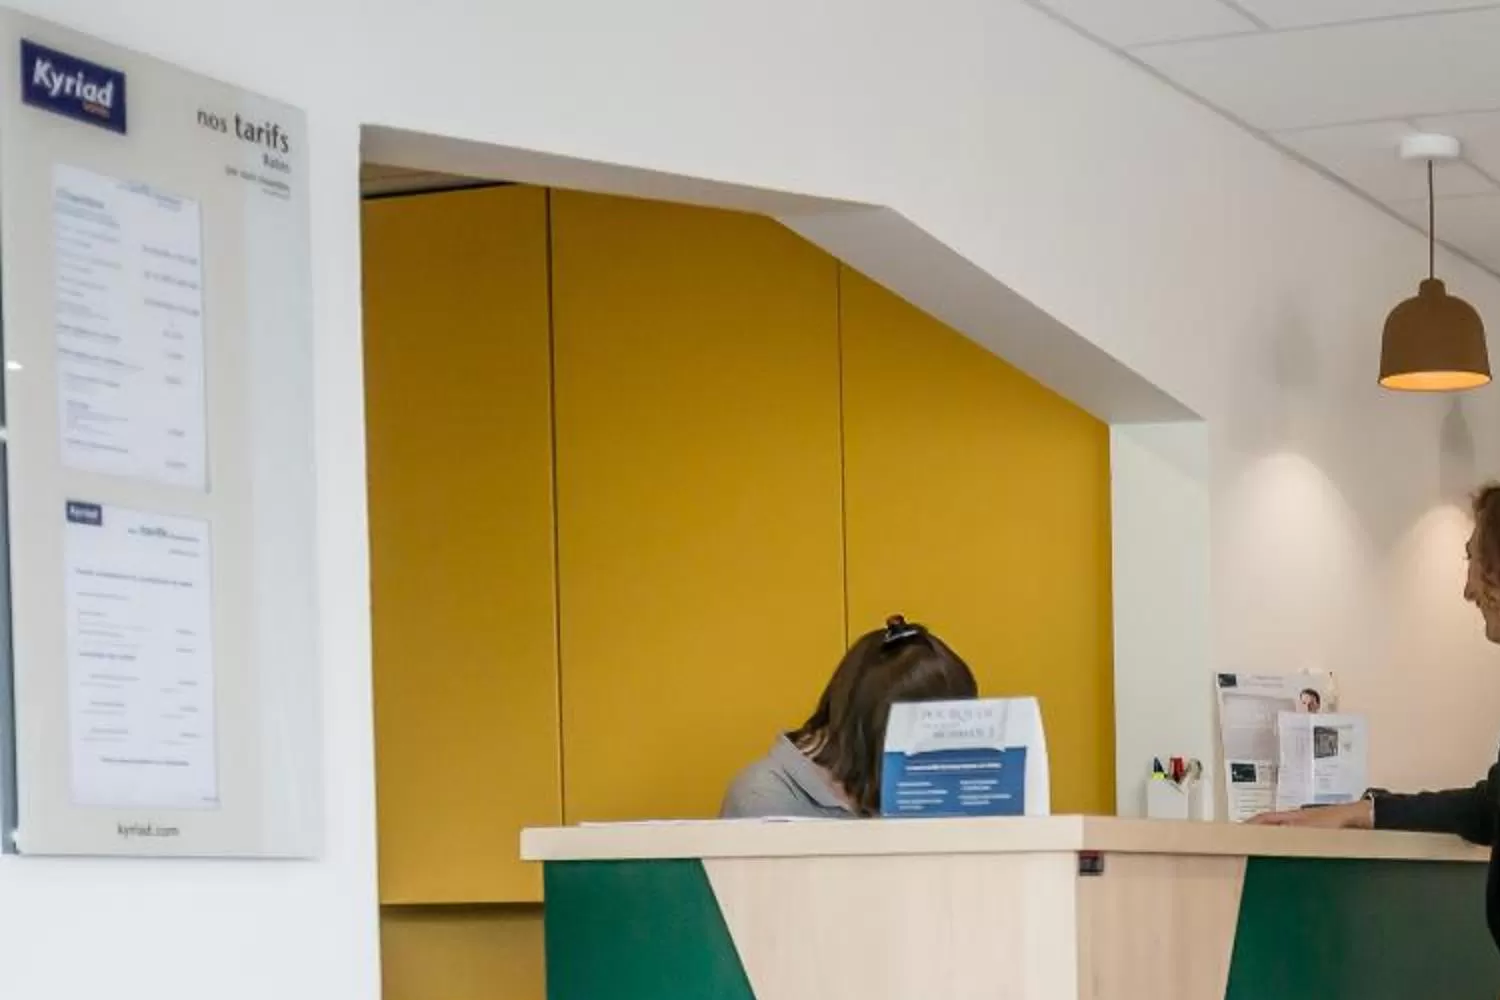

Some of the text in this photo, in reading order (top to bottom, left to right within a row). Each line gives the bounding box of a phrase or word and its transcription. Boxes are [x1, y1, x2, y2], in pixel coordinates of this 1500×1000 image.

[33, 58, 114, 108] Kyriad
[197, 110, 289, 153] nos tarifs
